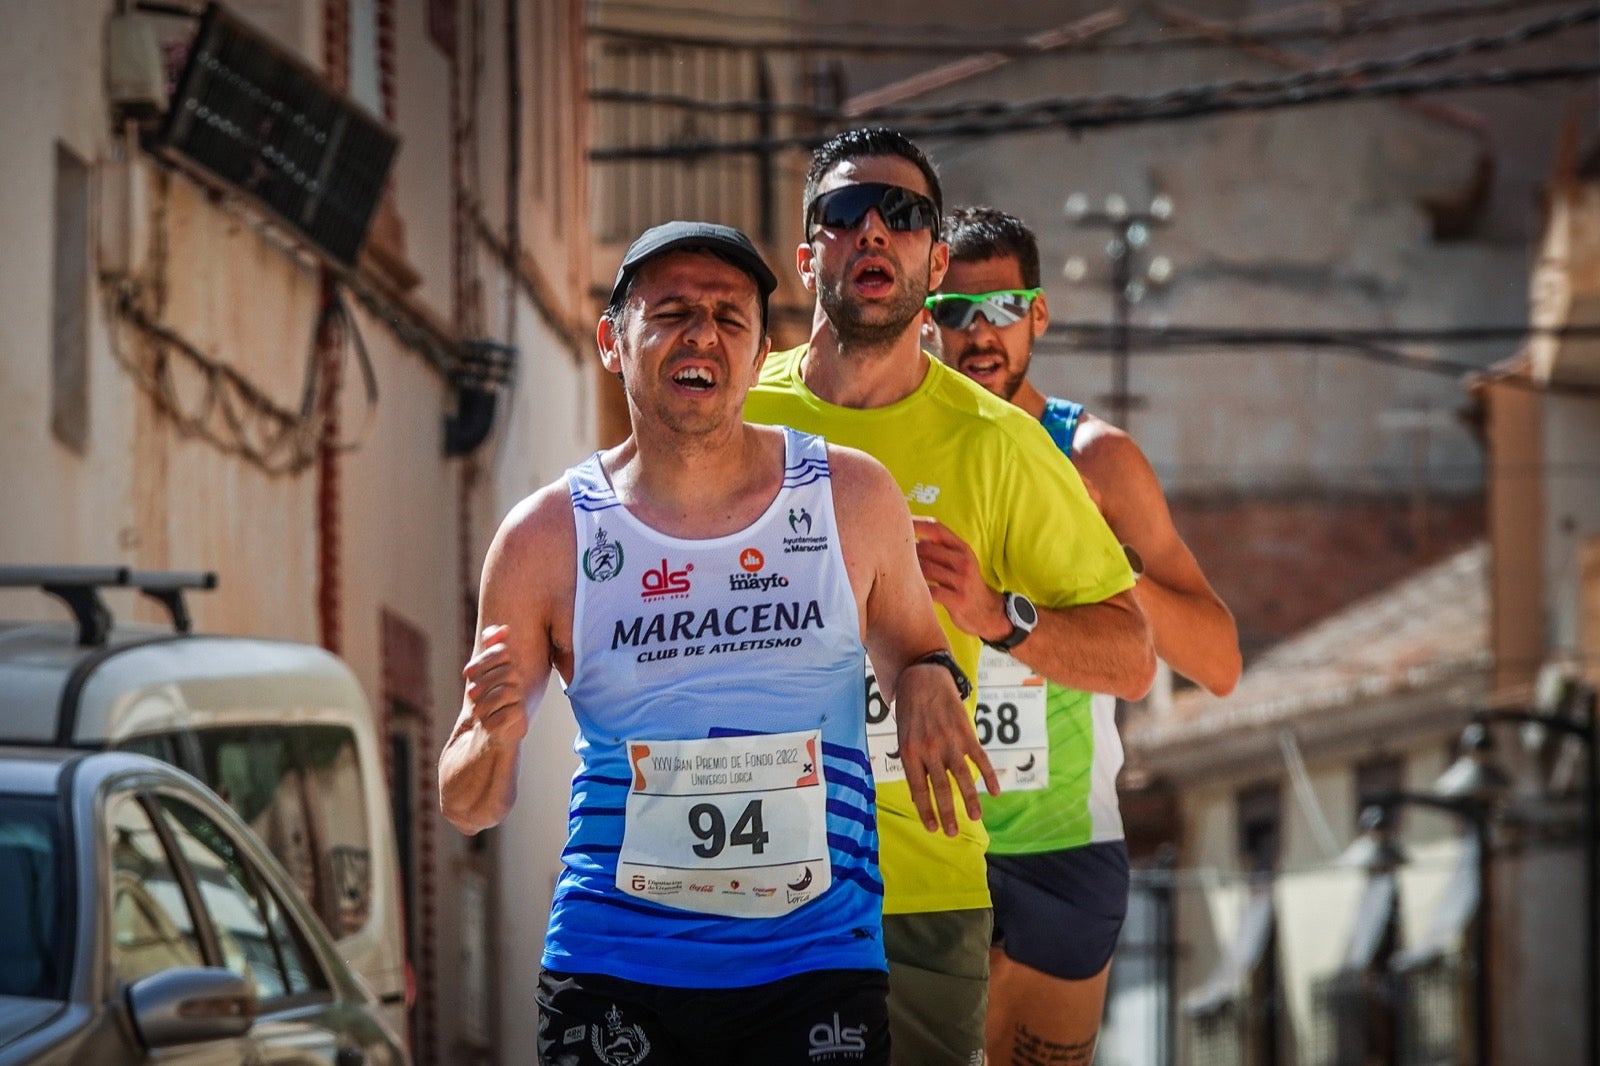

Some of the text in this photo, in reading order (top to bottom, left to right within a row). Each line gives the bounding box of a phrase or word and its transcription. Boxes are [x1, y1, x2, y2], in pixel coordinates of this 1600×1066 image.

[783, 535, 828, 546] Ayuntamiento
[792, 543, 828, 553] Maracena
[730, 573, 789, 592] mayfo
[611, 599, 825, 650] MARACENA
[637, 636, 802, 663] CLUB DE ATLETISMO
[695, 755, 728, 770] PREMIO
[731, 755, 742, 769] DE
[745, 752, 774, 768] FONDO
[776, 748, 798, 765] 2022
[691, 771, 753, 786] UNIVERSO LORCA
[688, 799, 769, 859] 94
[786, 890, 810, 904] Lorca
